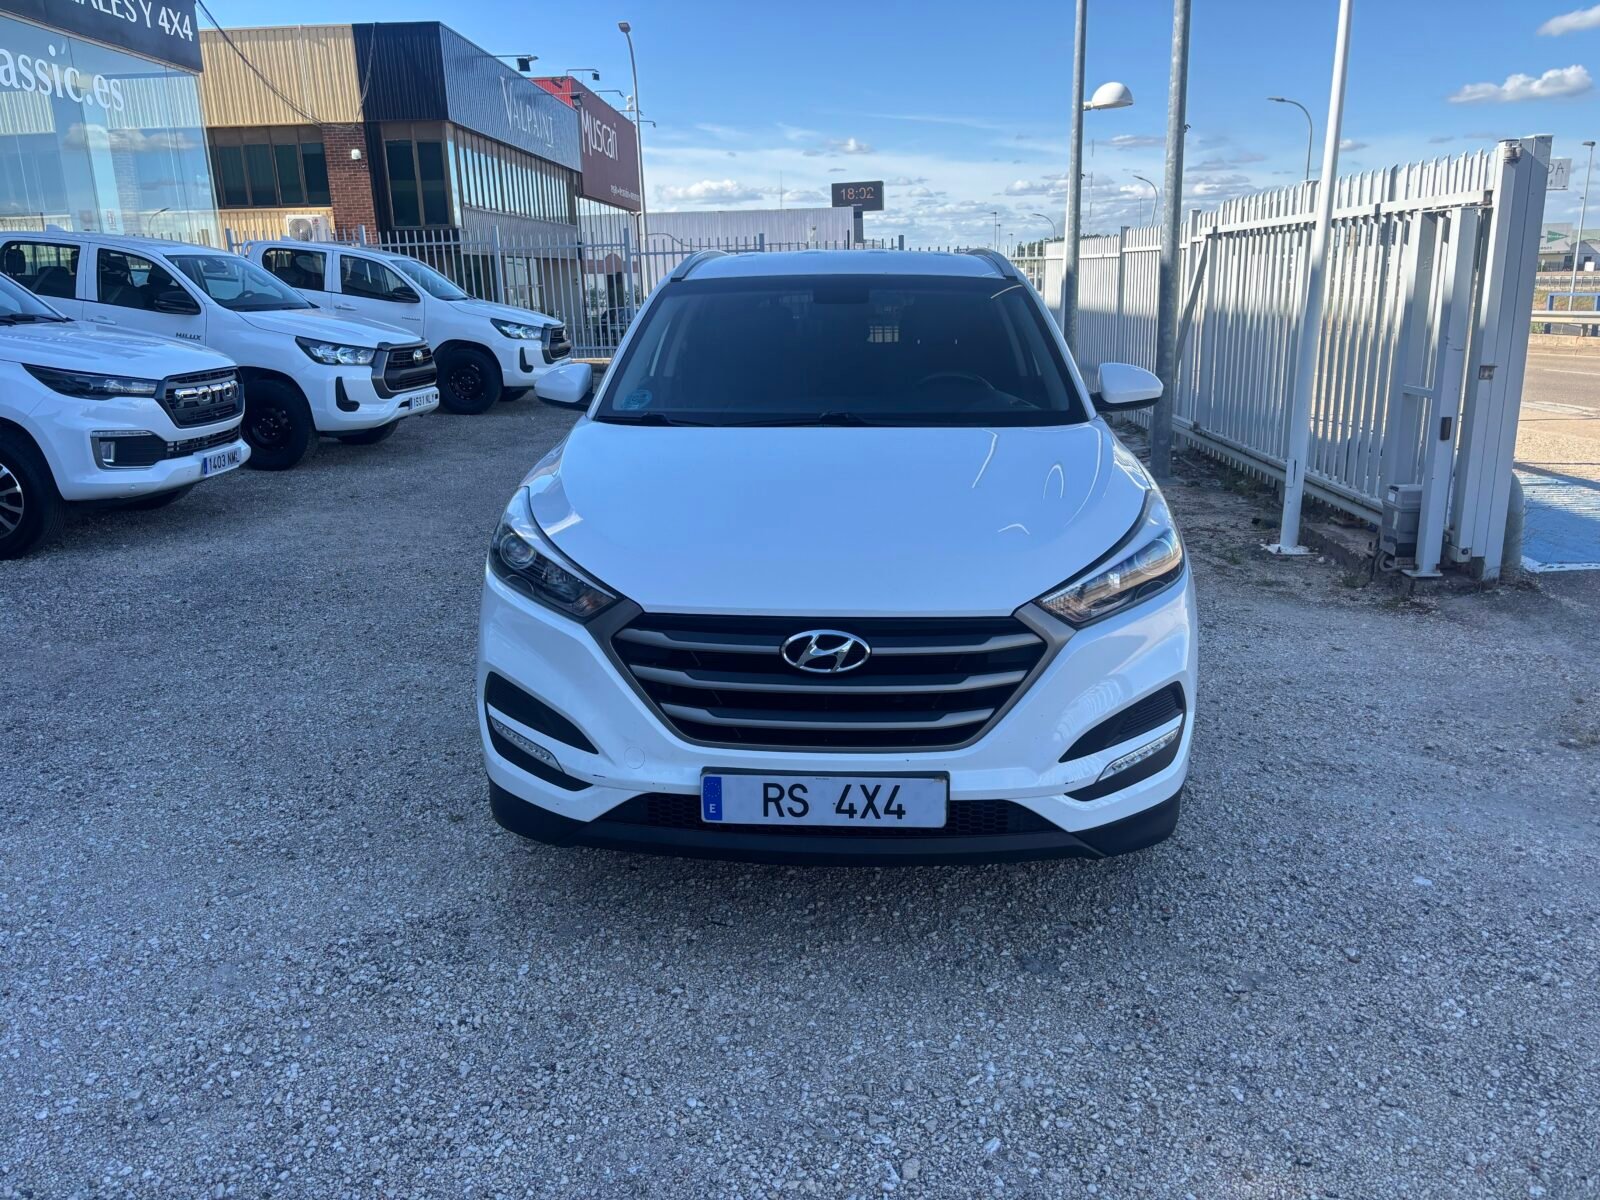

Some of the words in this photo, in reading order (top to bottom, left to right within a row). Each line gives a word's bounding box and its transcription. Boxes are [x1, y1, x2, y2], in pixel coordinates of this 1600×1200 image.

[158, 6, 193, 41] 4X4
[841, 187, 874, 200] 18:02
[176, 332, 201, 340] HILUX
[209, 454, 226, 471] 1403
[709, 803, 716, 813] E
[762, 782, 809, 818] RS
[835, 784, 906, 819] 4X4
